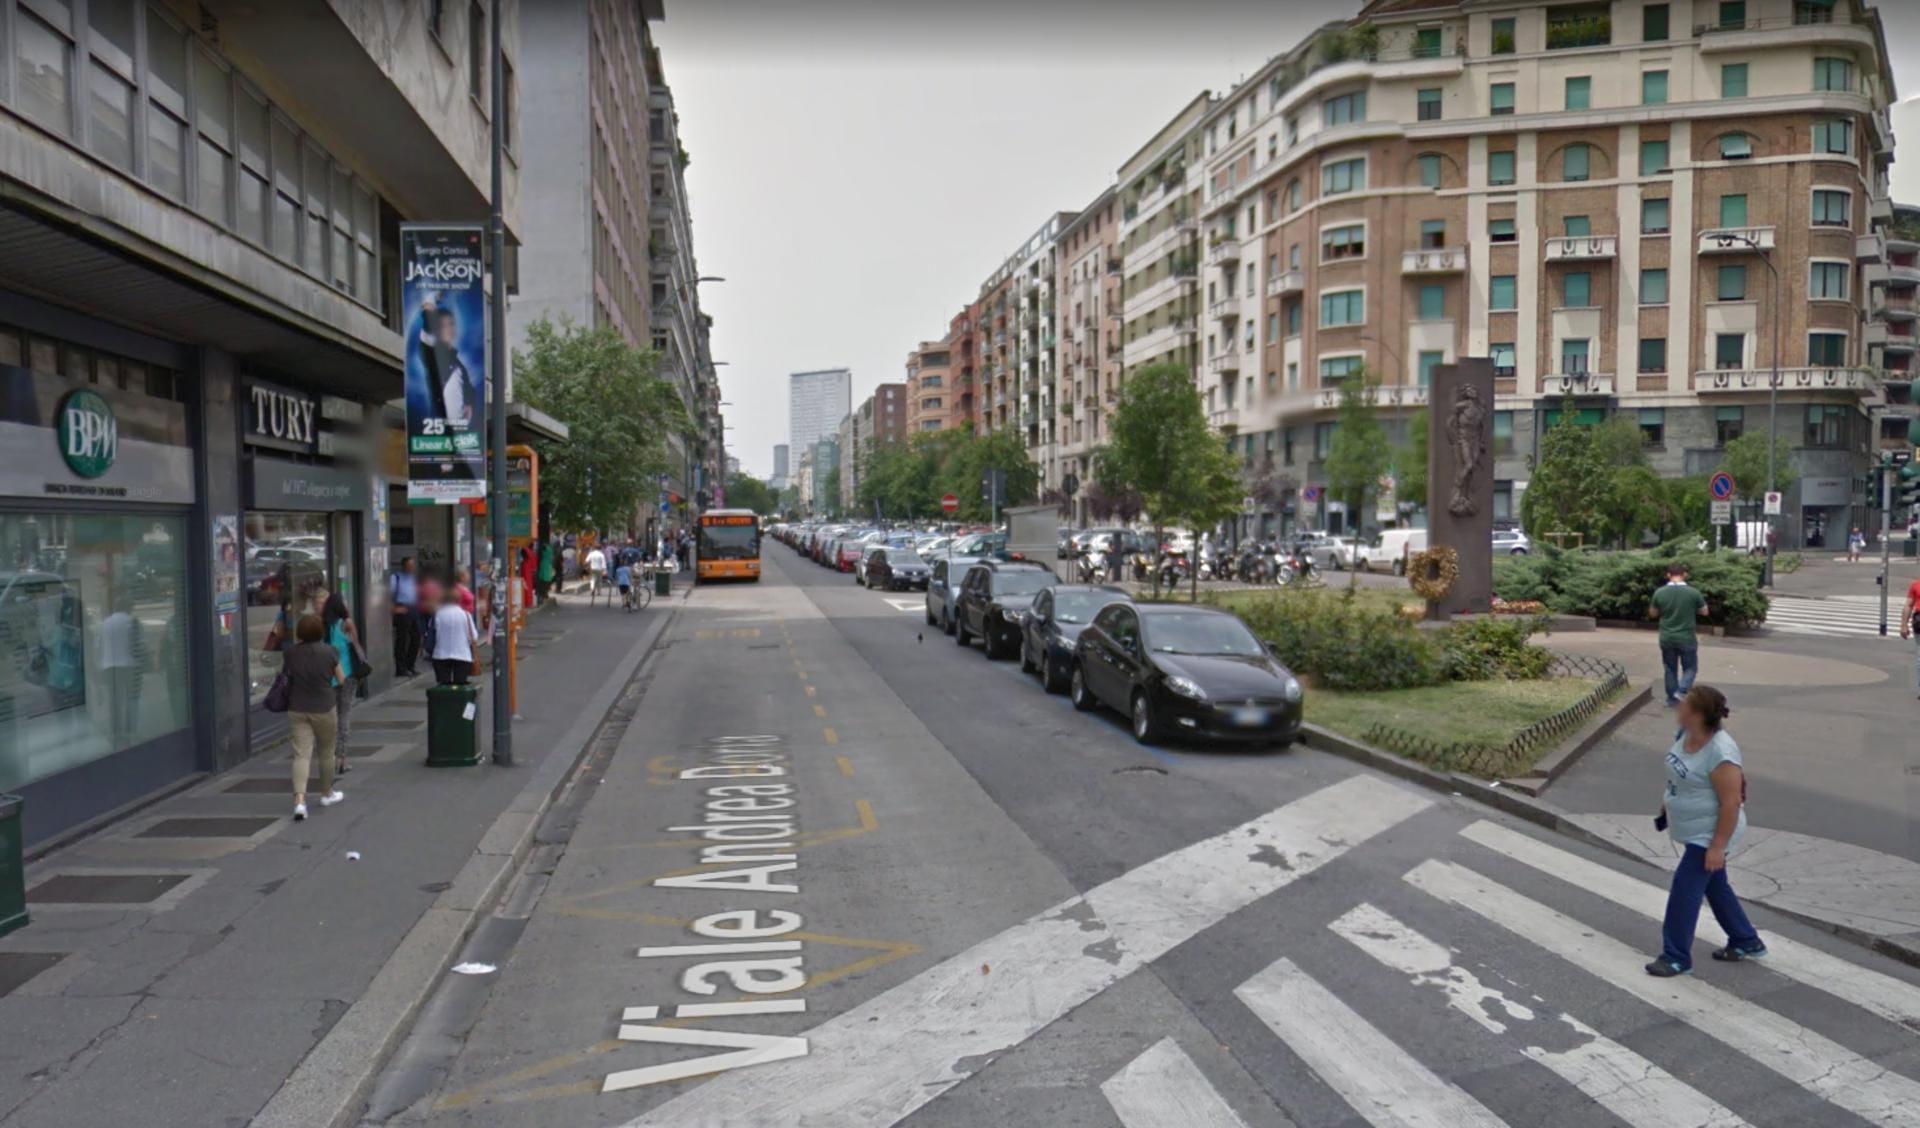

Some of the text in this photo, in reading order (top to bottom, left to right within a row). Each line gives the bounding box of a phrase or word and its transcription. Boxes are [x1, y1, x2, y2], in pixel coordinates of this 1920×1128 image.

[405, 258, 482, 283] JACKSON
[252, 386, 315, 443] TURY
[422, 418, 445, 435] 25
[67, 408, 118, 461] BPM
